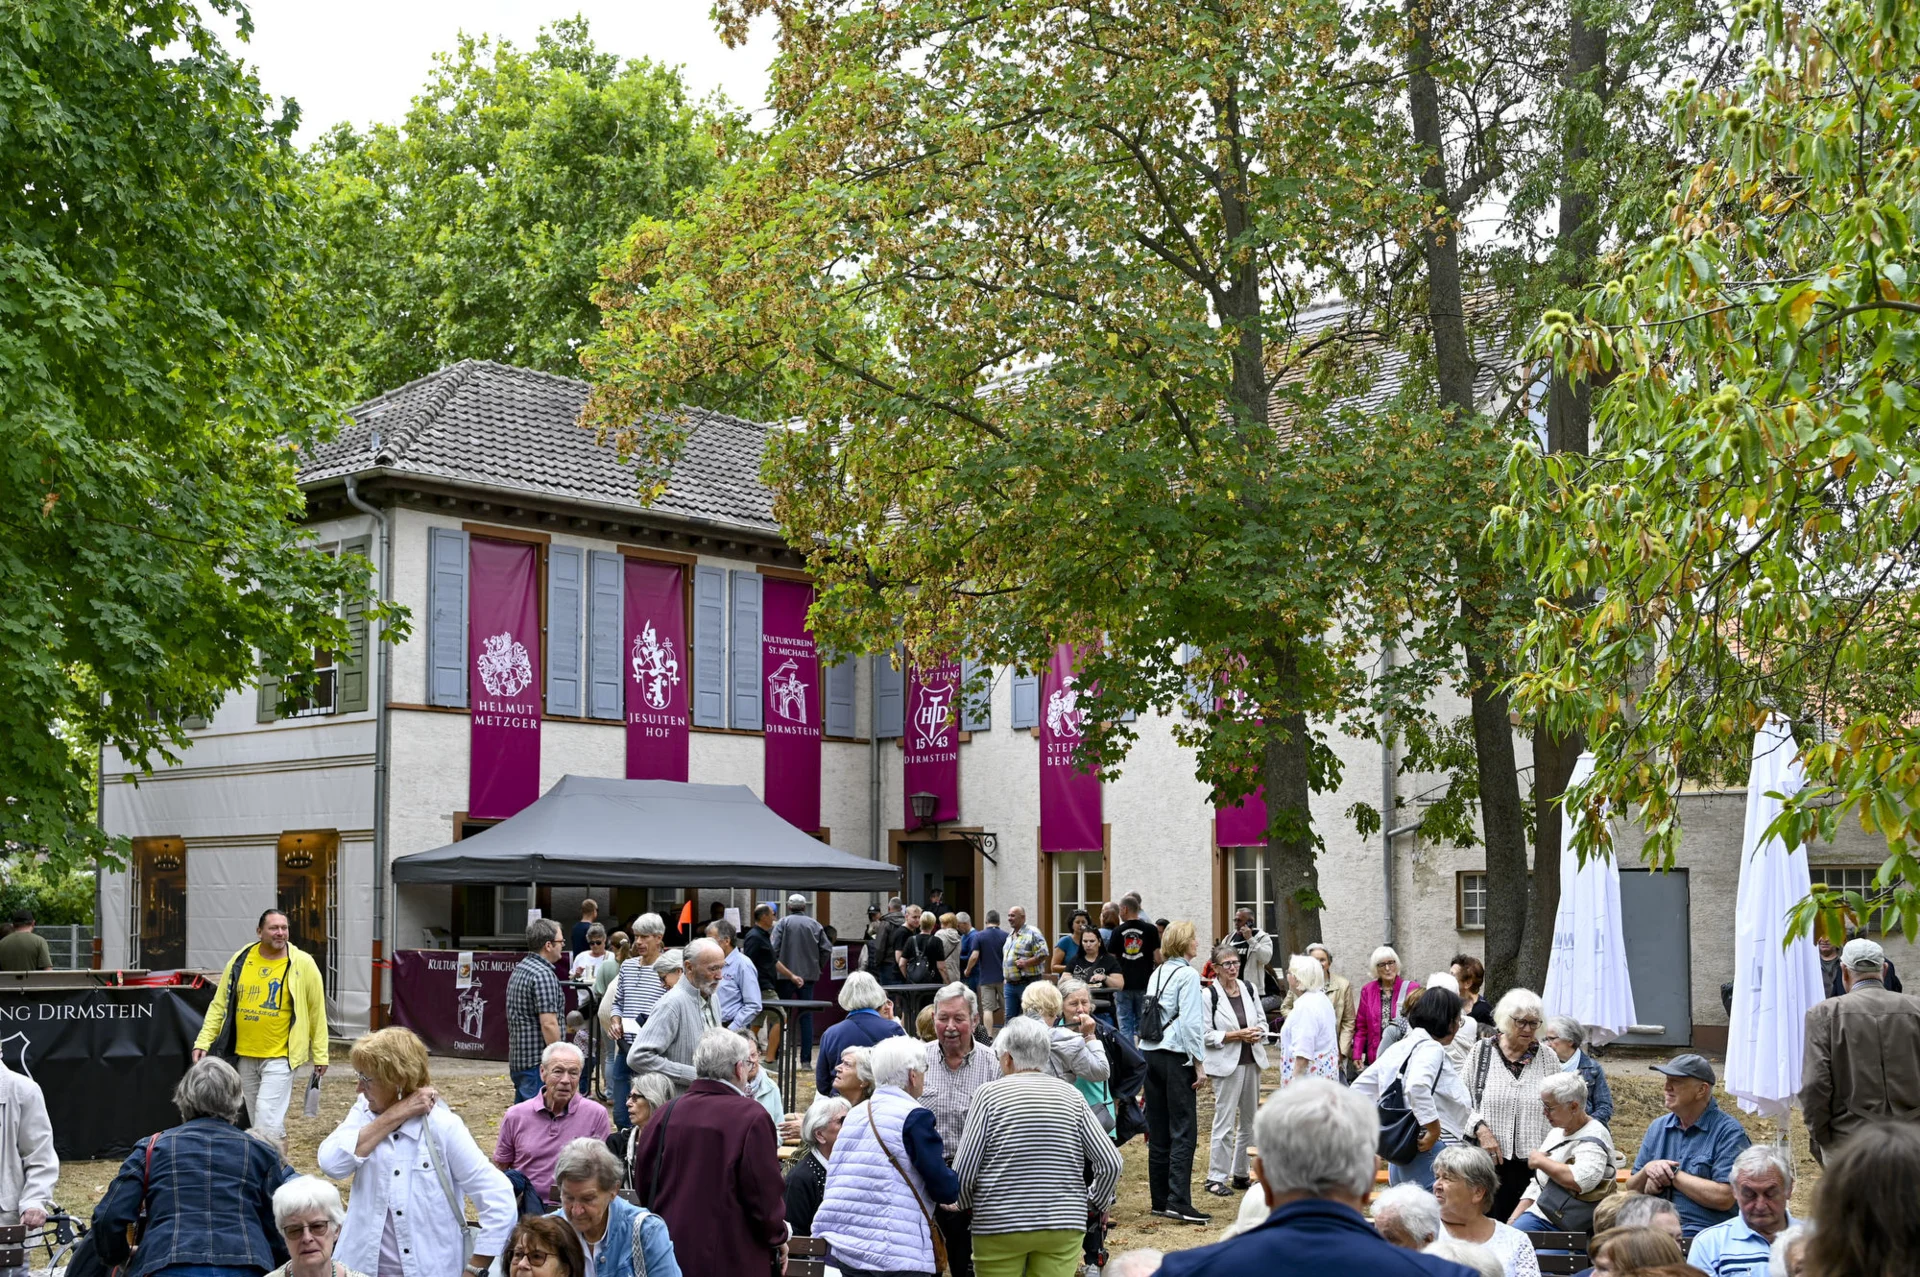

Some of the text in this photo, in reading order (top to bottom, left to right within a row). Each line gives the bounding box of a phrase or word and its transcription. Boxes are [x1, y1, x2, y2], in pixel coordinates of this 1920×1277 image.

[763, 634, 813, 647] KULTURVEREIN
[768, 646, 778, 655] ST.
[779, 648, 809, 658] MICHAEL
[479, 700, 534, 715] HELMUT
[475, 715, 537, 729] METZGER
[629, 712, 686, 726] JESUITEN
[645, 727, 670, 738] HOF
[766, 723, 819, 736] DIRMSTEIN
[915, 736, 948, 750] 15 43
[904, 752, 957, 764] DIRMSTEIN
[480, 960, 490, 971] ST.
[38, 1003, 153, 1020] DIRMSTEIN
[454, 1041, 485, 1050] DIRMSTEIN
